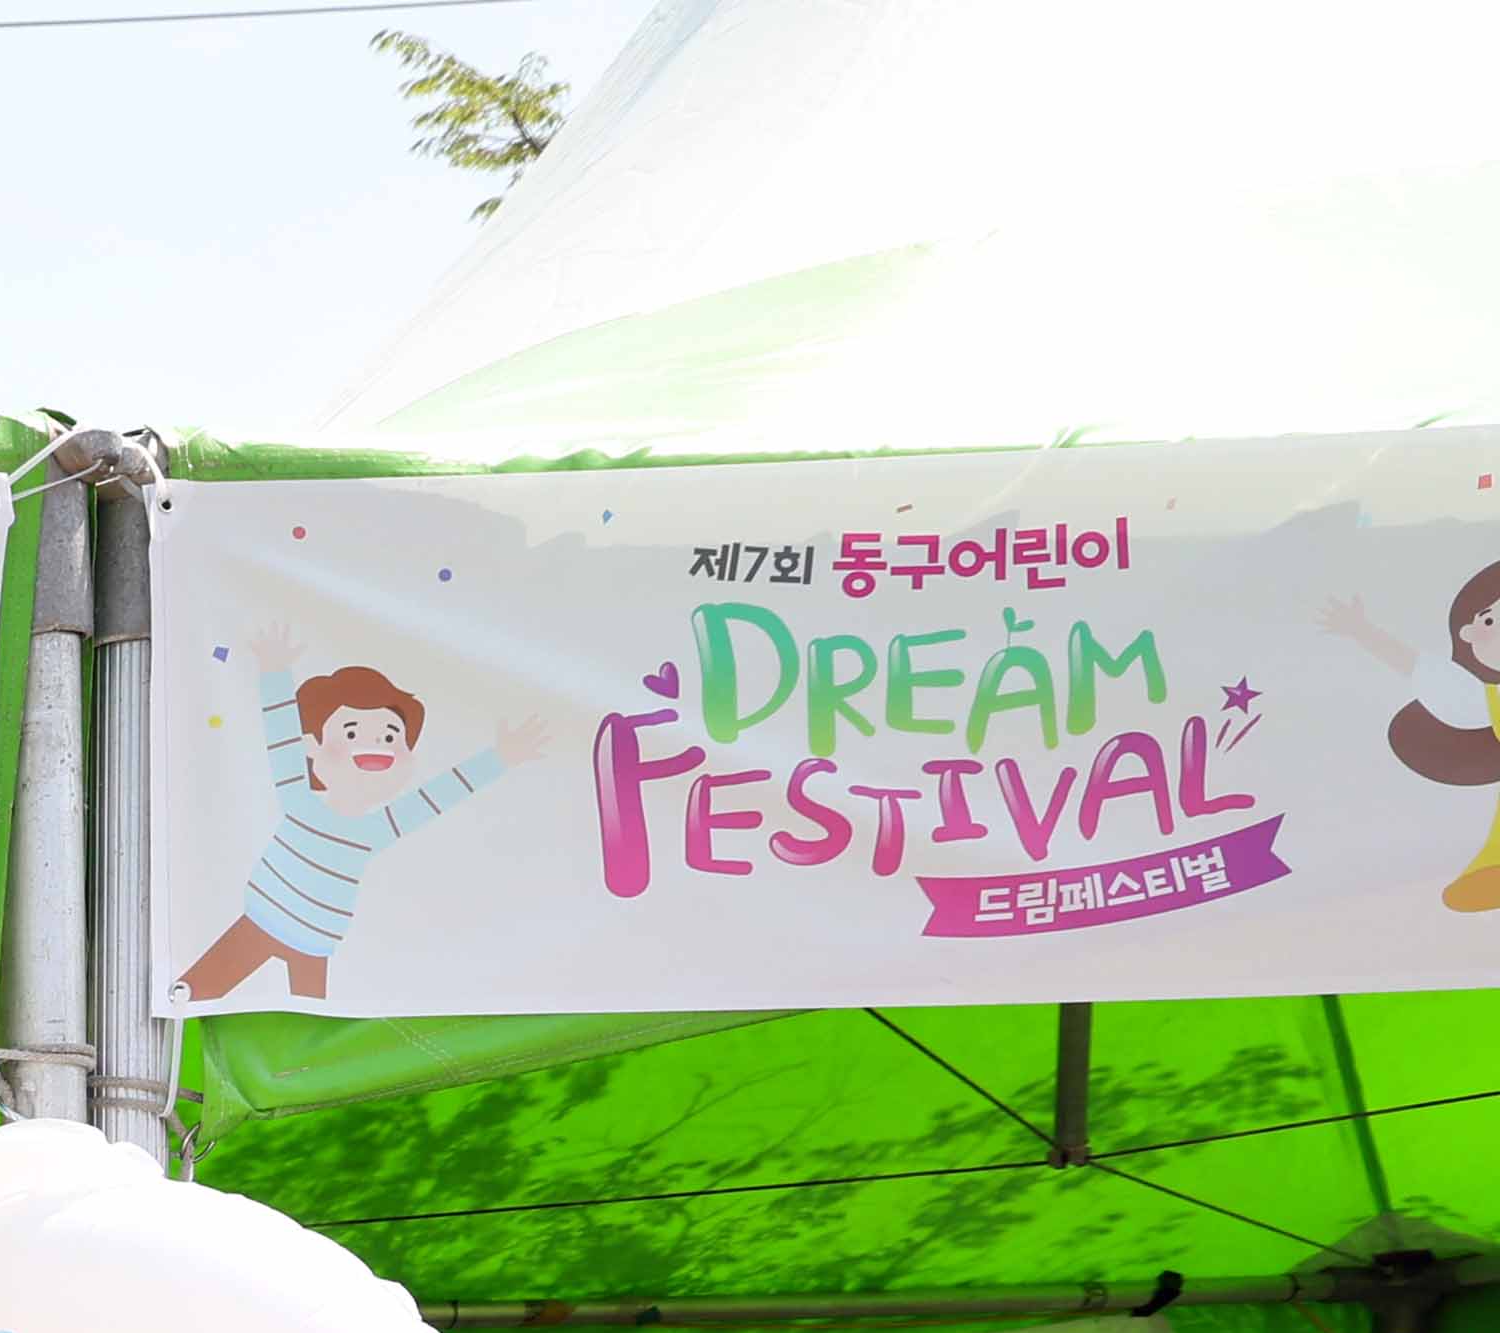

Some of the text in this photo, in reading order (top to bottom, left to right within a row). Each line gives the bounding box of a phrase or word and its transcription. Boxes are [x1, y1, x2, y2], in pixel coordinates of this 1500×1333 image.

[688, 516, 1130, 599] 제7회 동구어린이
[690, 601, 1168, 757] DREAM
[593, 708, 1256, 898] FESTIVAL
[974, 846, 1233, 926] 드림페스티벌
